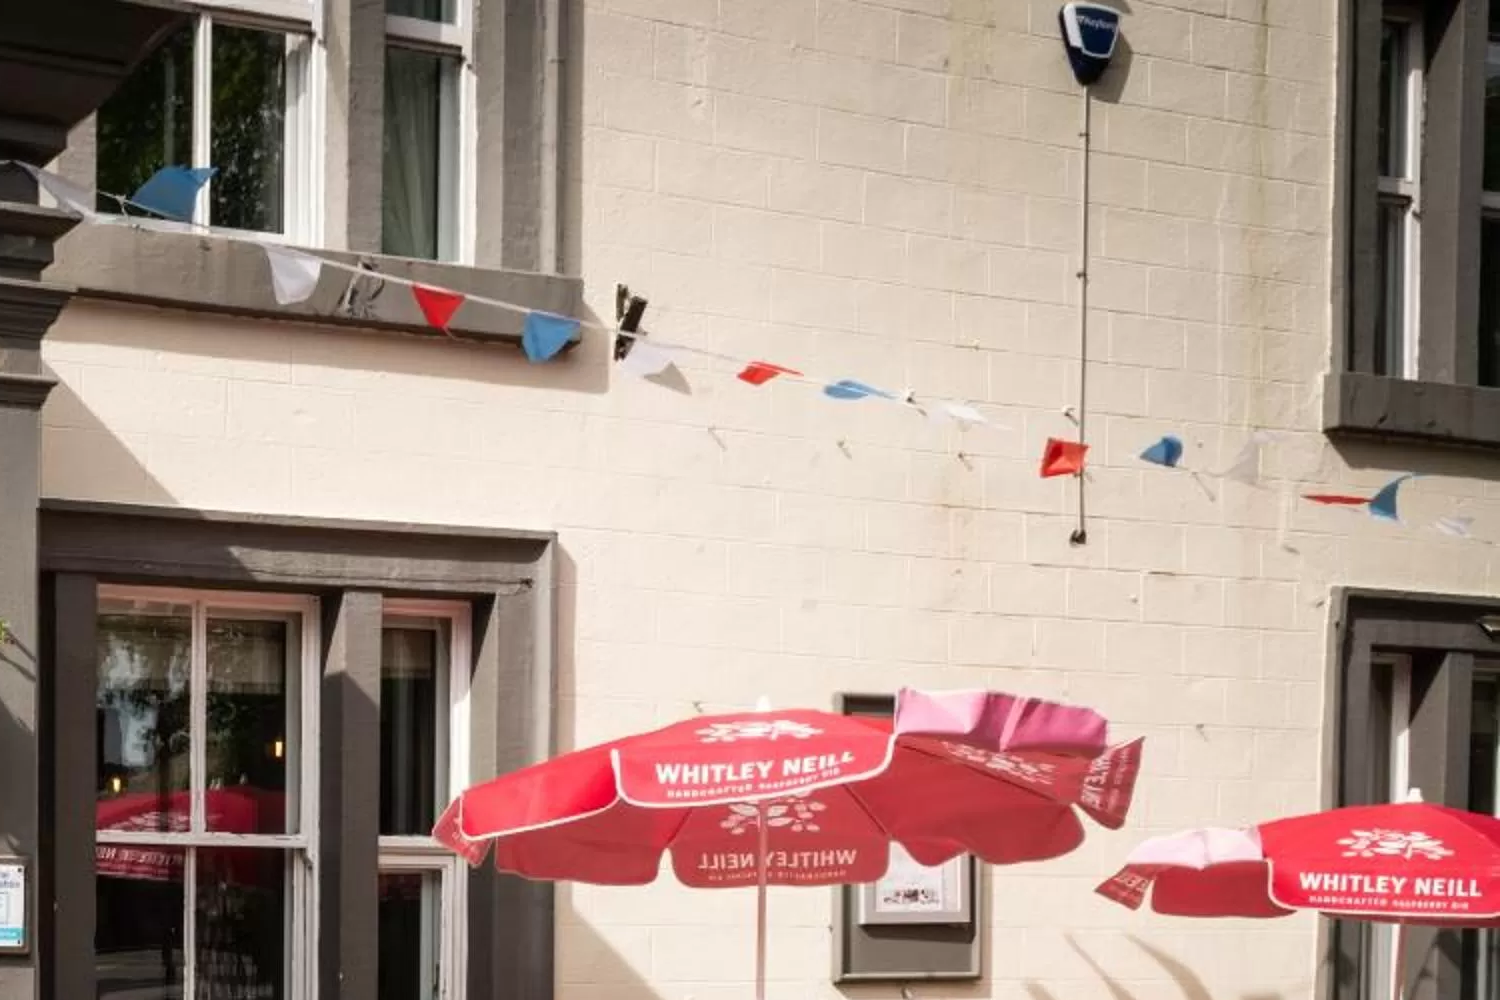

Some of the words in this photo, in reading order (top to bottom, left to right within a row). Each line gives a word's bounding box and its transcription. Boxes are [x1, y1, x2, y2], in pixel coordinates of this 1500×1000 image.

[655, 760, 774, 785] WHITLEY
[783, 751, 856, 776] NEILL
[1299, 871, 1408, 894] WHITLEY
[1414, 877, 1482, 897] NEILL
